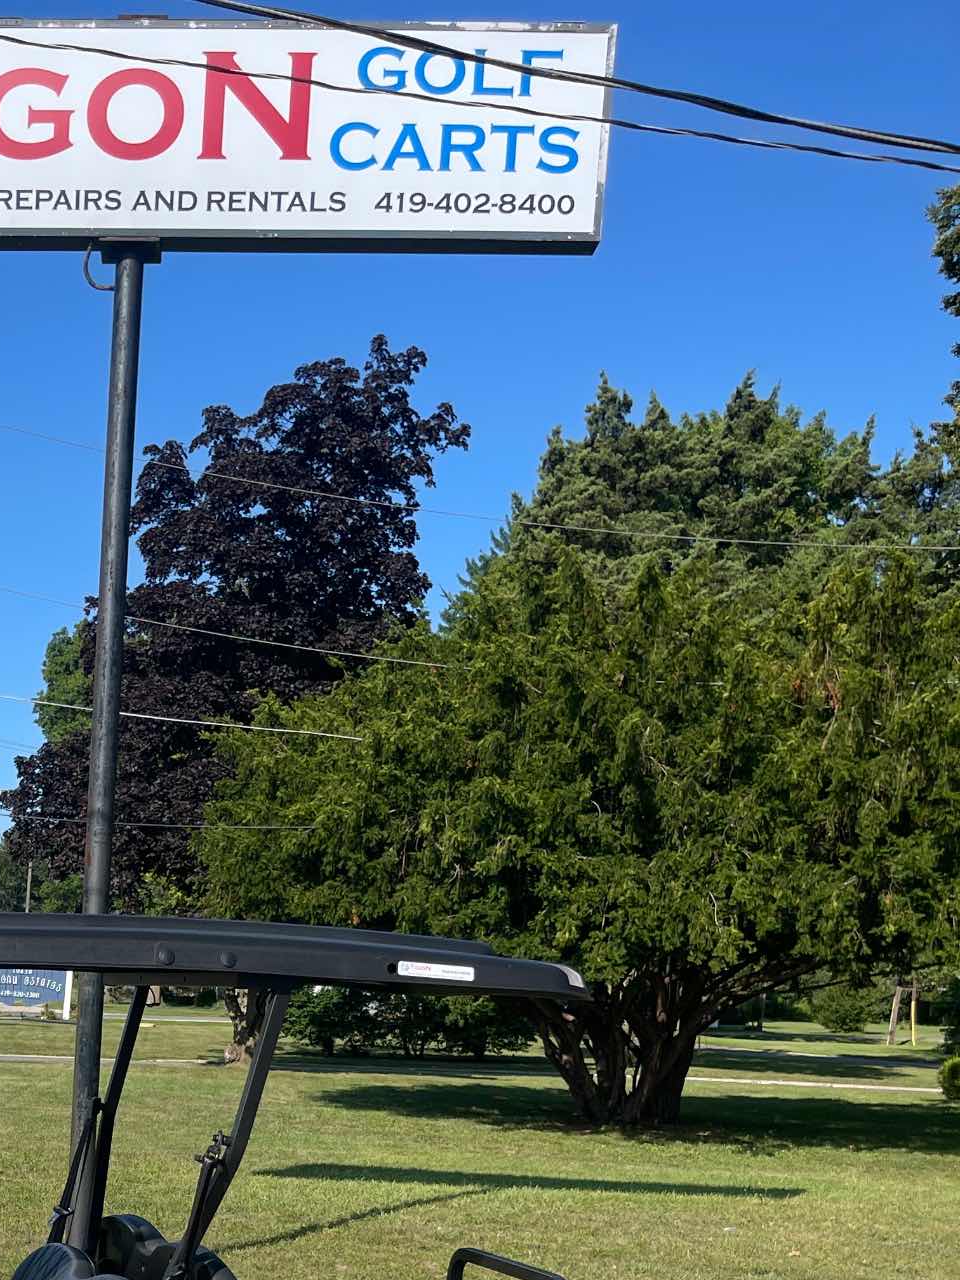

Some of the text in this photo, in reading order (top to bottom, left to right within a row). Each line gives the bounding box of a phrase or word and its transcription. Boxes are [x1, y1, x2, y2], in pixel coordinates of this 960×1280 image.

[357, 47, 564, 97] GOLF
[329, 122, 580, 174] CARTS
[131, 190, 197, 212] AND
[206, 190, 346, 213] RENTALS
[374, 191, 575, 215] 419-402-8400
